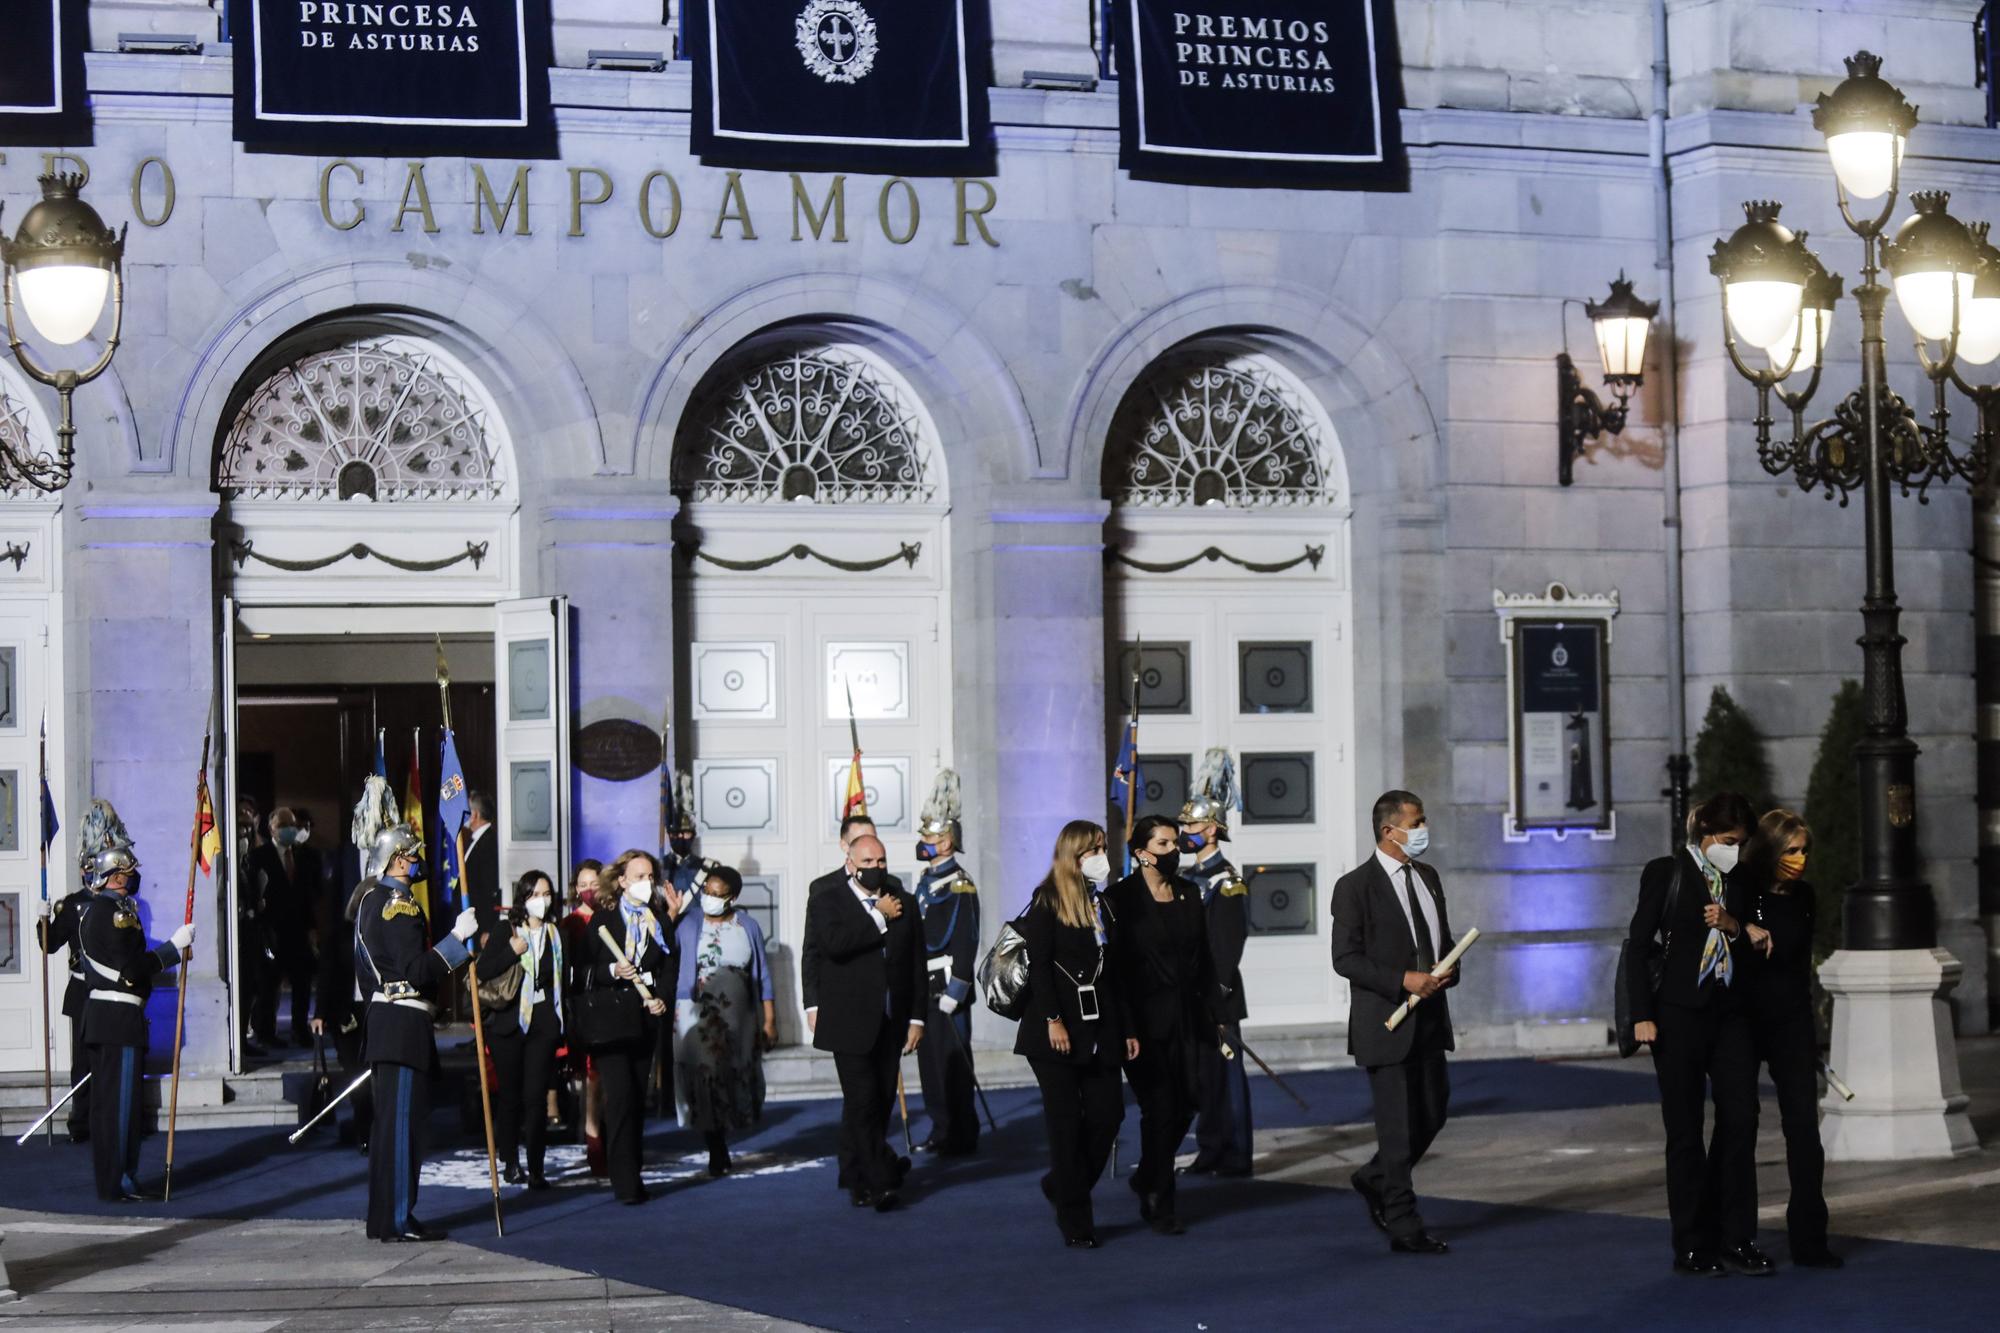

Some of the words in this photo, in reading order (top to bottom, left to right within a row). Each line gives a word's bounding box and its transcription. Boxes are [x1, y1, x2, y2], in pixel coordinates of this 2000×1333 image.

[299, 1, 478, 28] PRINCESA
[1173, 12, 1329, 44] PREMIOS
[301, 30, 336, 48] DE
[348, 32, 480, 53] ASTURIAS
[1176, 42, 1333, 71] PRINCESA
[1179, 69, 1210, 87] DE
[1222, 72, 1336, 94] ASTURIAS
[319, 158, 1001, 247] CAMPOAMOR
